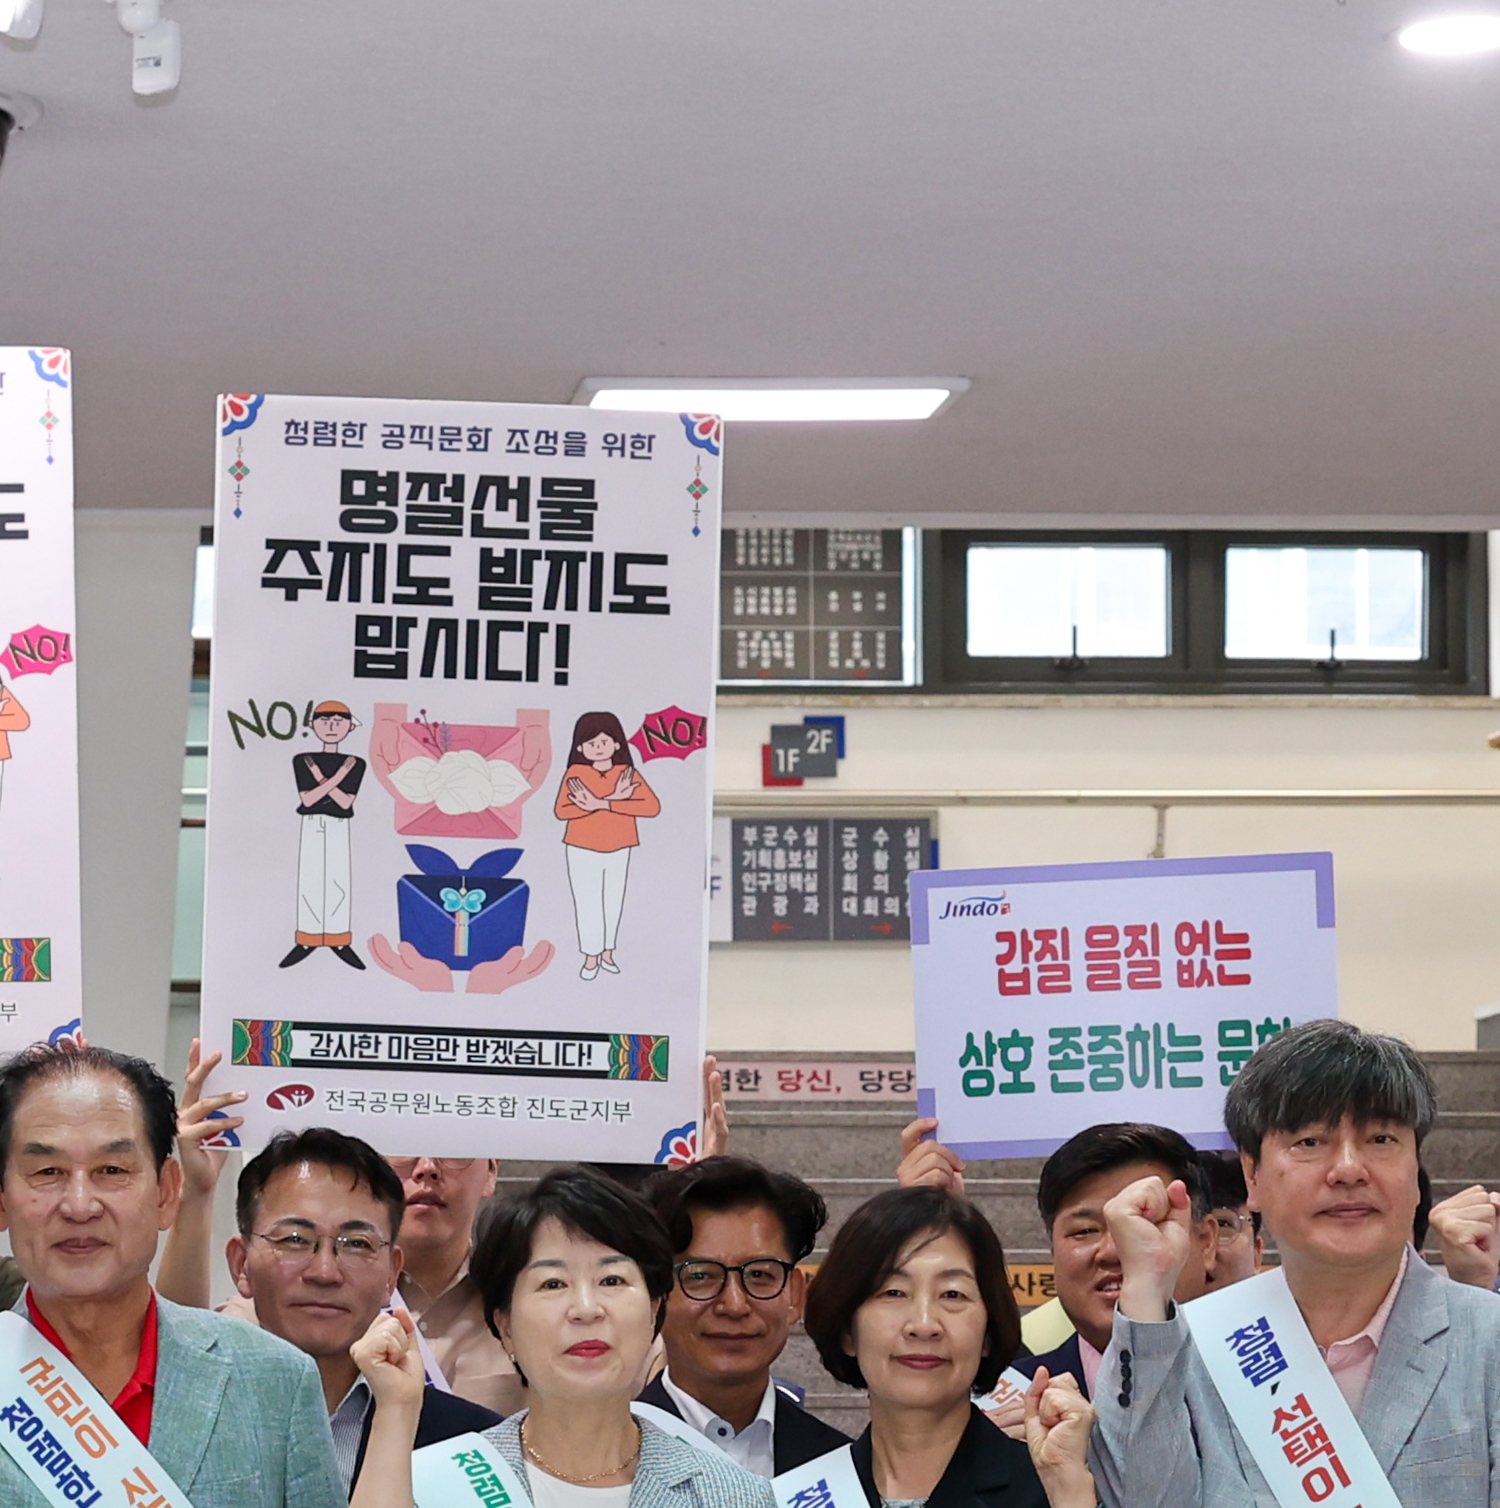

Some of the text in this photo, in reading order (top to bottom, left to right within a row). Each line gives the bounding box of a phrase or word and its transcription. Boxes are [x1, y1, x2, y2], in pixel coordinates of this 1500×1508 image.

[284, 418, 655, 460] 청렴한 공직문화 조성을 위한
[339, 468, 598, 543] 명절선물
[261, 538, 453, 607] 주지도
[479, 546, 670, 615] 받지도
[7, 633, 73, 671] NO!
[353, 615, 570, 686] 맙시다!
[227, 700, 312, 750] NO!
[643, 714, 707, 749] NO!
[806, 729, 833, 754] 2F
[776, 748, 800, 773] 1F
[995, 919, 1253, 997] 갑질 을질 없는
[309, 1033, 593, 1068] 감사한 마음만 받겠습니다!
[959, 1021, 1204, 1099] 상호 존중하는
[777, 1069, 842, 1094] 당신,
[325, 1088, 634, 1124] 전국공무원노동조합 진도군지부
[19, 1355, 120, 1460] 군민이
[1271, 1393, 1352, 1503] 선택이
